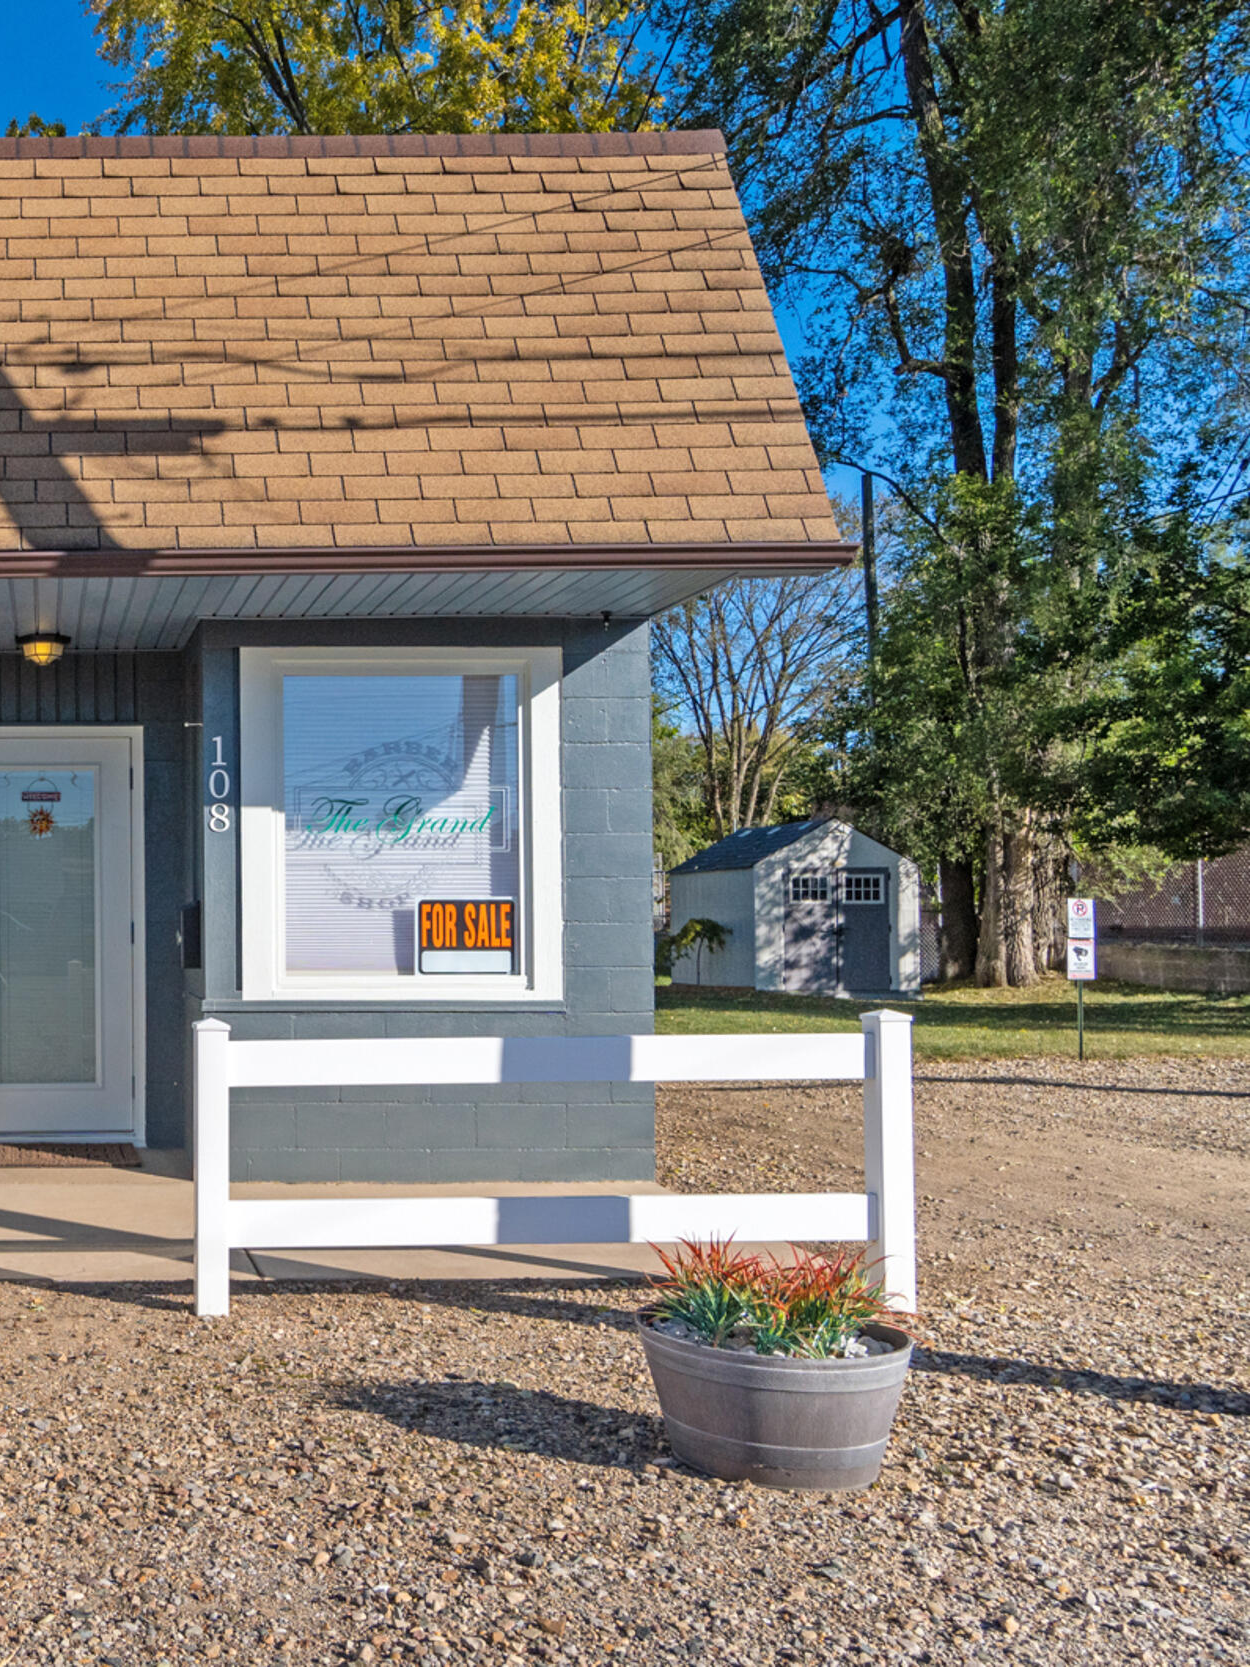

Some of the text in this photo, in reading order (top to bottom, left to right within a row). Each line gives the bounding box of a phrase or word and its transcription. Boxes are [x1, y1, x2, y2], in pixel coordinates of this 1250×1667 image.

[342, 740, 458, 776] BARBER
[208, 735, 231, 832] 108
[306, 794, 498, 845] The Grand
[421, 903, 512, 948] FOR SALE
